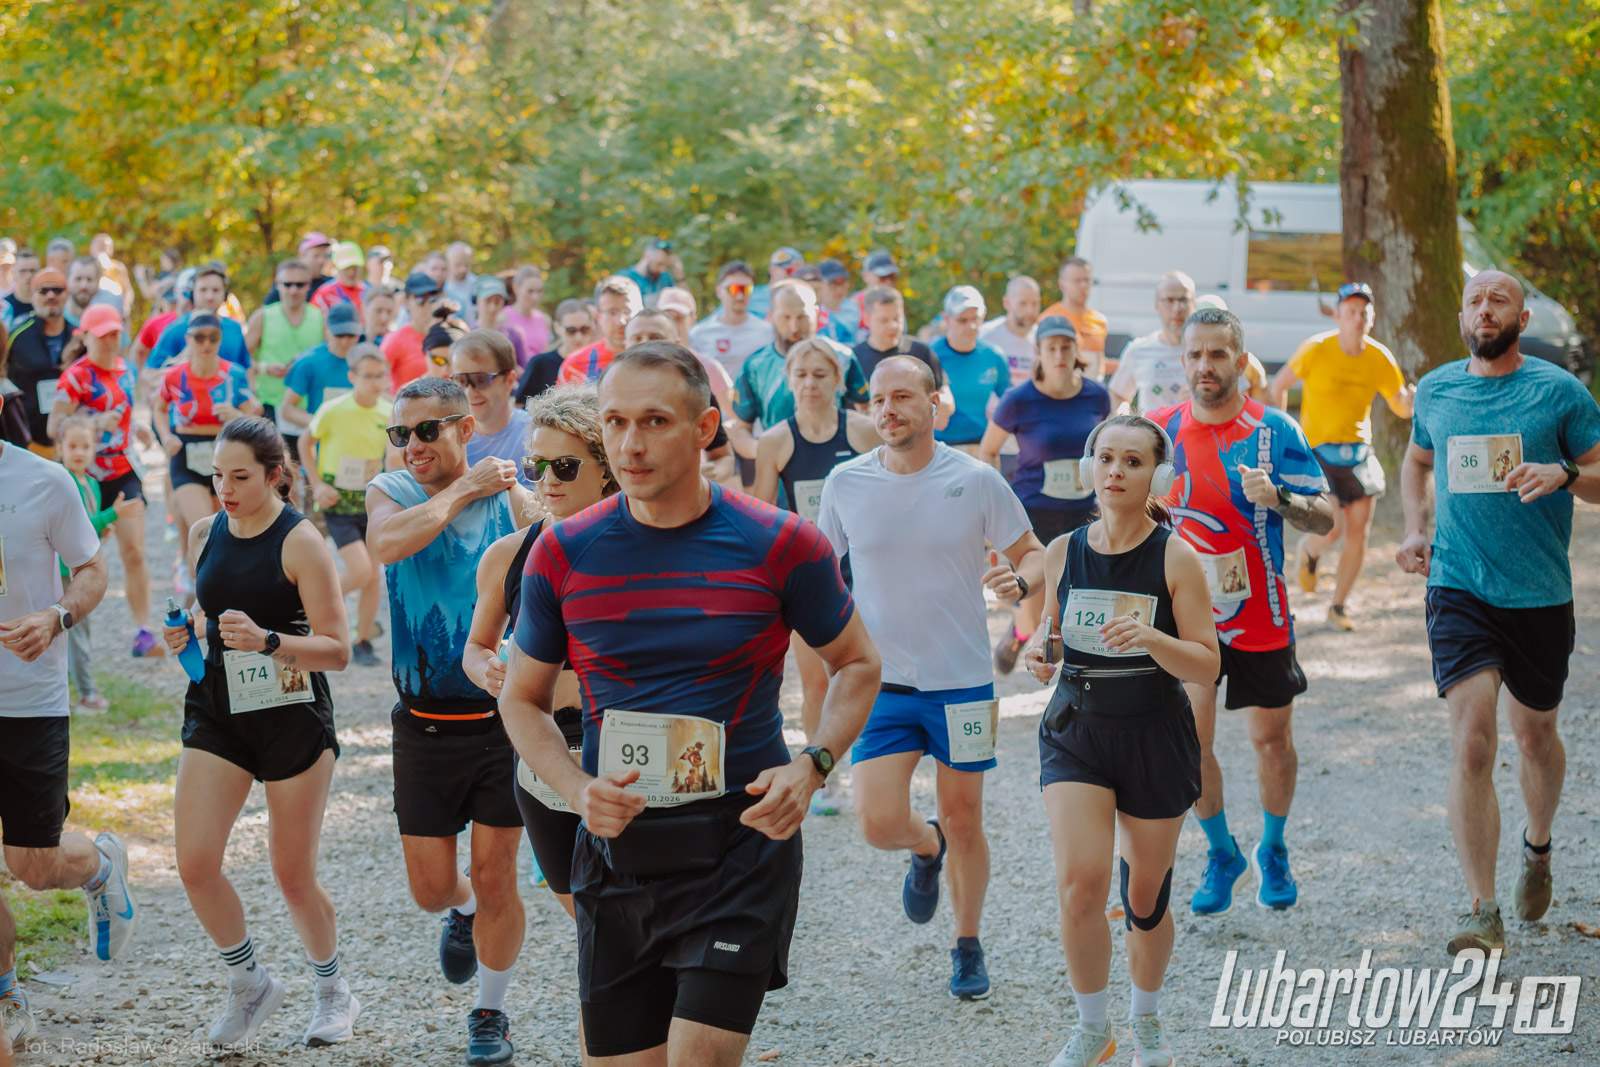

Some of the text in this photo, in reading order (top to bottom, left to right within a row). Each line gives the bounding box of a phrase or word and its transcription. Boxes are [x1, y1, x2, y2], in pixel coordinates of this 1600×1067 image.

[1460, 454, 1479, 468] 36
[1075, 610, 1105, 627] 124
[237, 665, 269, 684] 174
[963, 721, 982, 736] 95
[621, 743, 649, 766] 93
